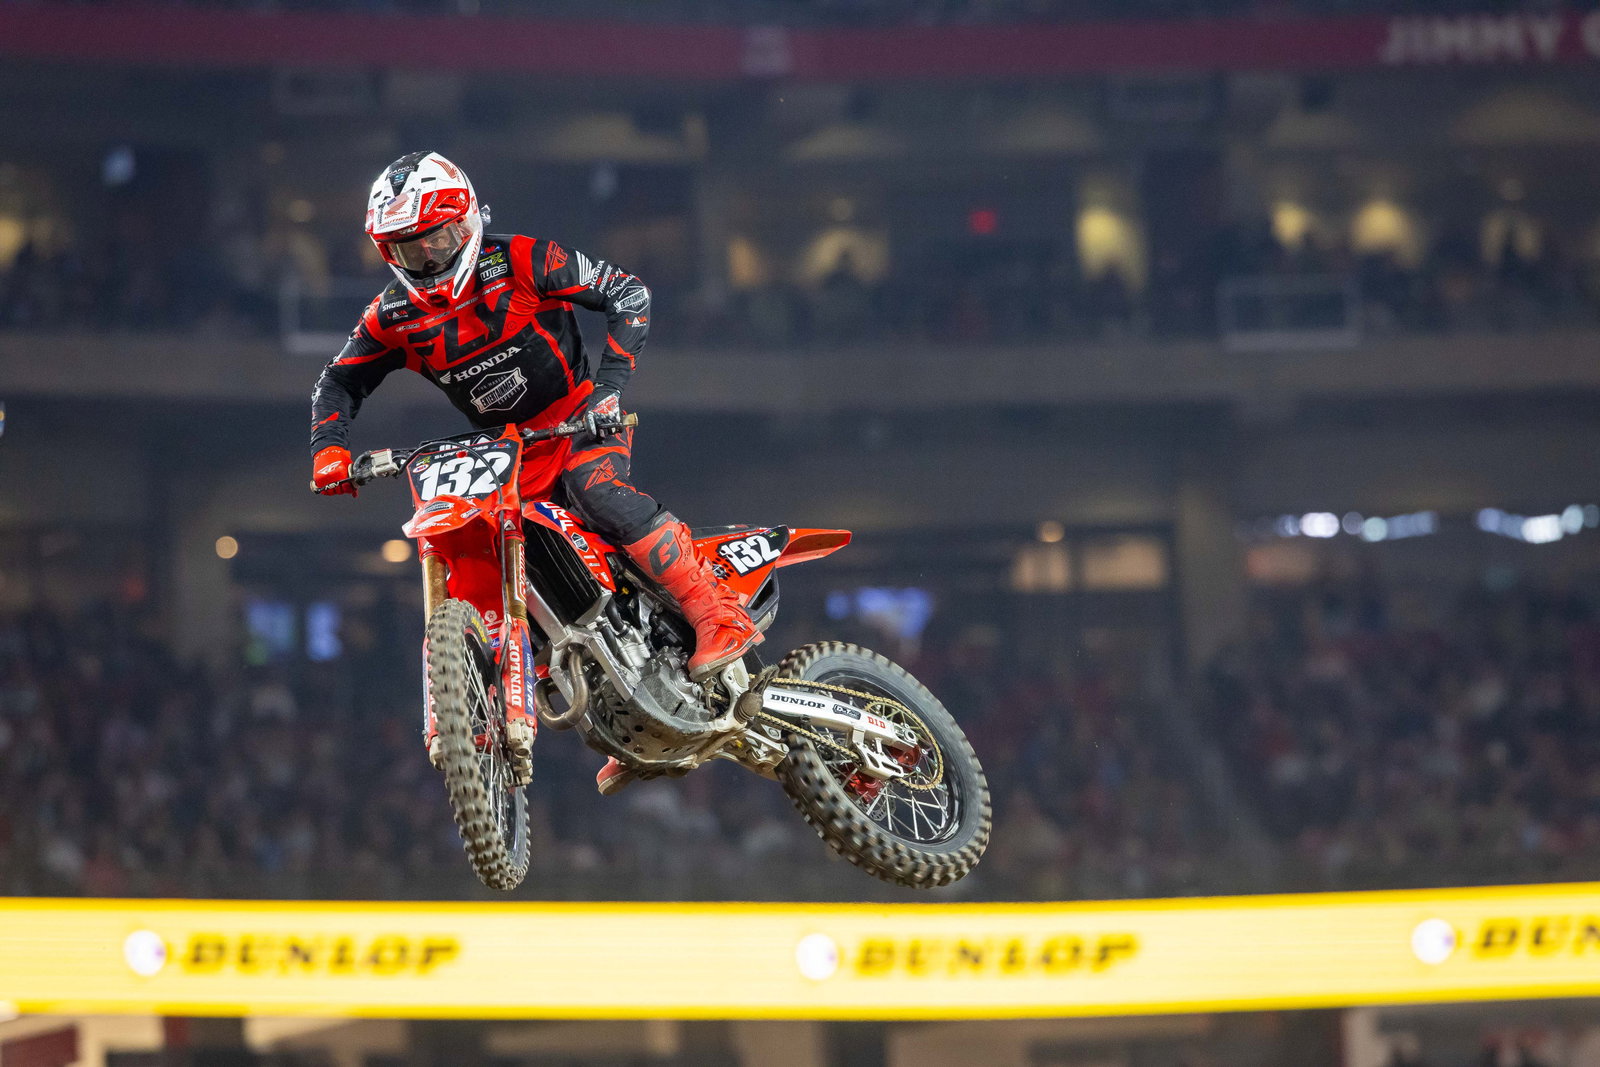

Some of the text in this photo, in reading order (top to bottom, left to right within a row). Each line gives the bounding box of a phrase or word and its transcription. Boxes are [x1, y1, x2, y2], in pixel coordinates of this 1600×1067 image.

[480, 264, 508, 281] WPS
[589, 260, 605, 289] HONDA
[382, 300, 407, 312] SHOWA
[454, 346, 522, 382] HONDA
[419, 451, 511, 501] 132
[540, 501, 574, 532] CRF
[718, 535, 782, 574] 132
[508, 640, 522, 707] DUNLOP
[771, 694, 825, 709] DUNLOP
[867, 716, 886, 729] DID
[183, 932, 461, 975] DUNLOP
[855, 933, 1138, 976] DUNLOP
